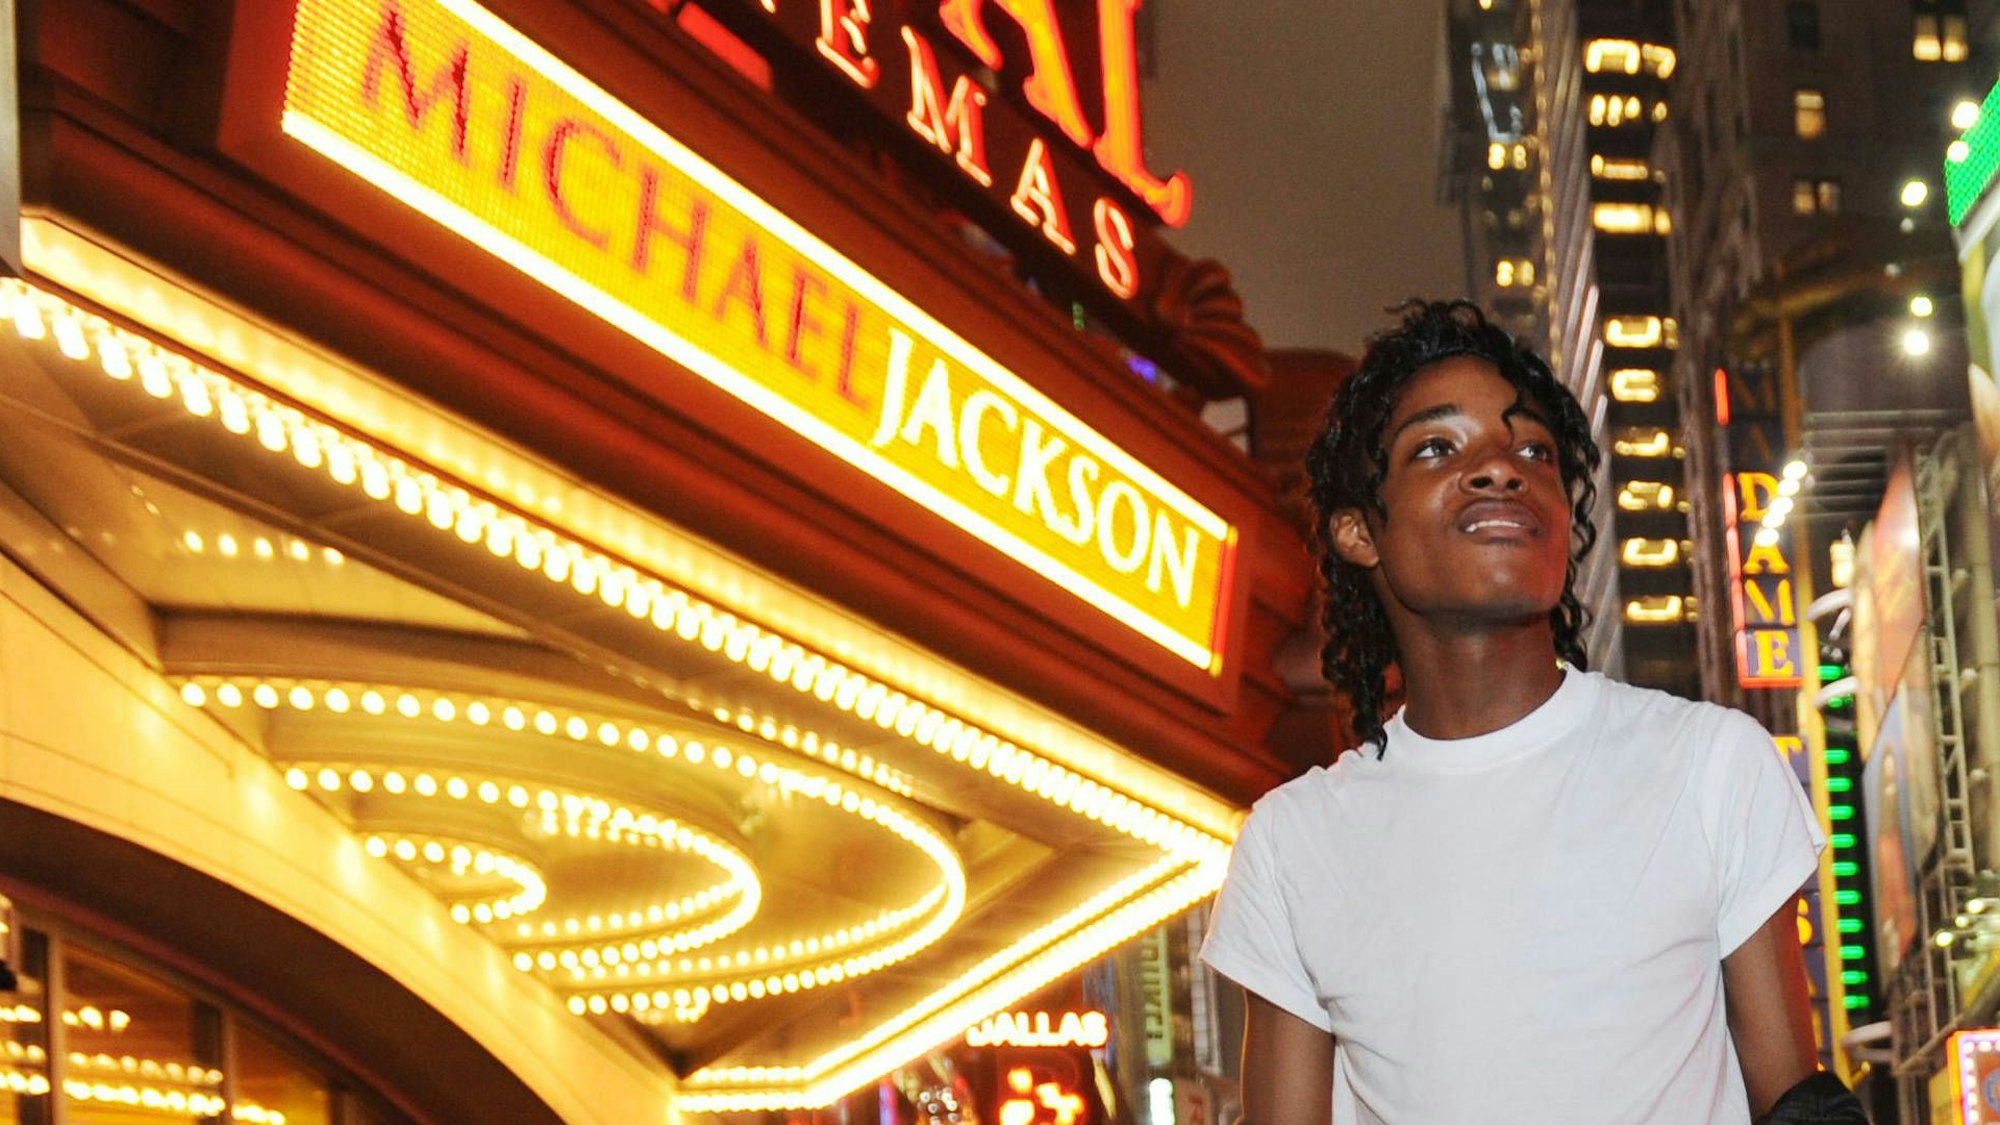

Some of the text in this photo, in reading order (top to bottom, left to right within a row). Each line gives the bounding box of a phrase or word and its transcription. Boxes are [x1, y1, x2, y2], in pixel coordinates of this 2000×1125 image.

[357, 0, 1200, 610] MICHAEL JACKSON
[760, 0, 1140, 300] EMAS
